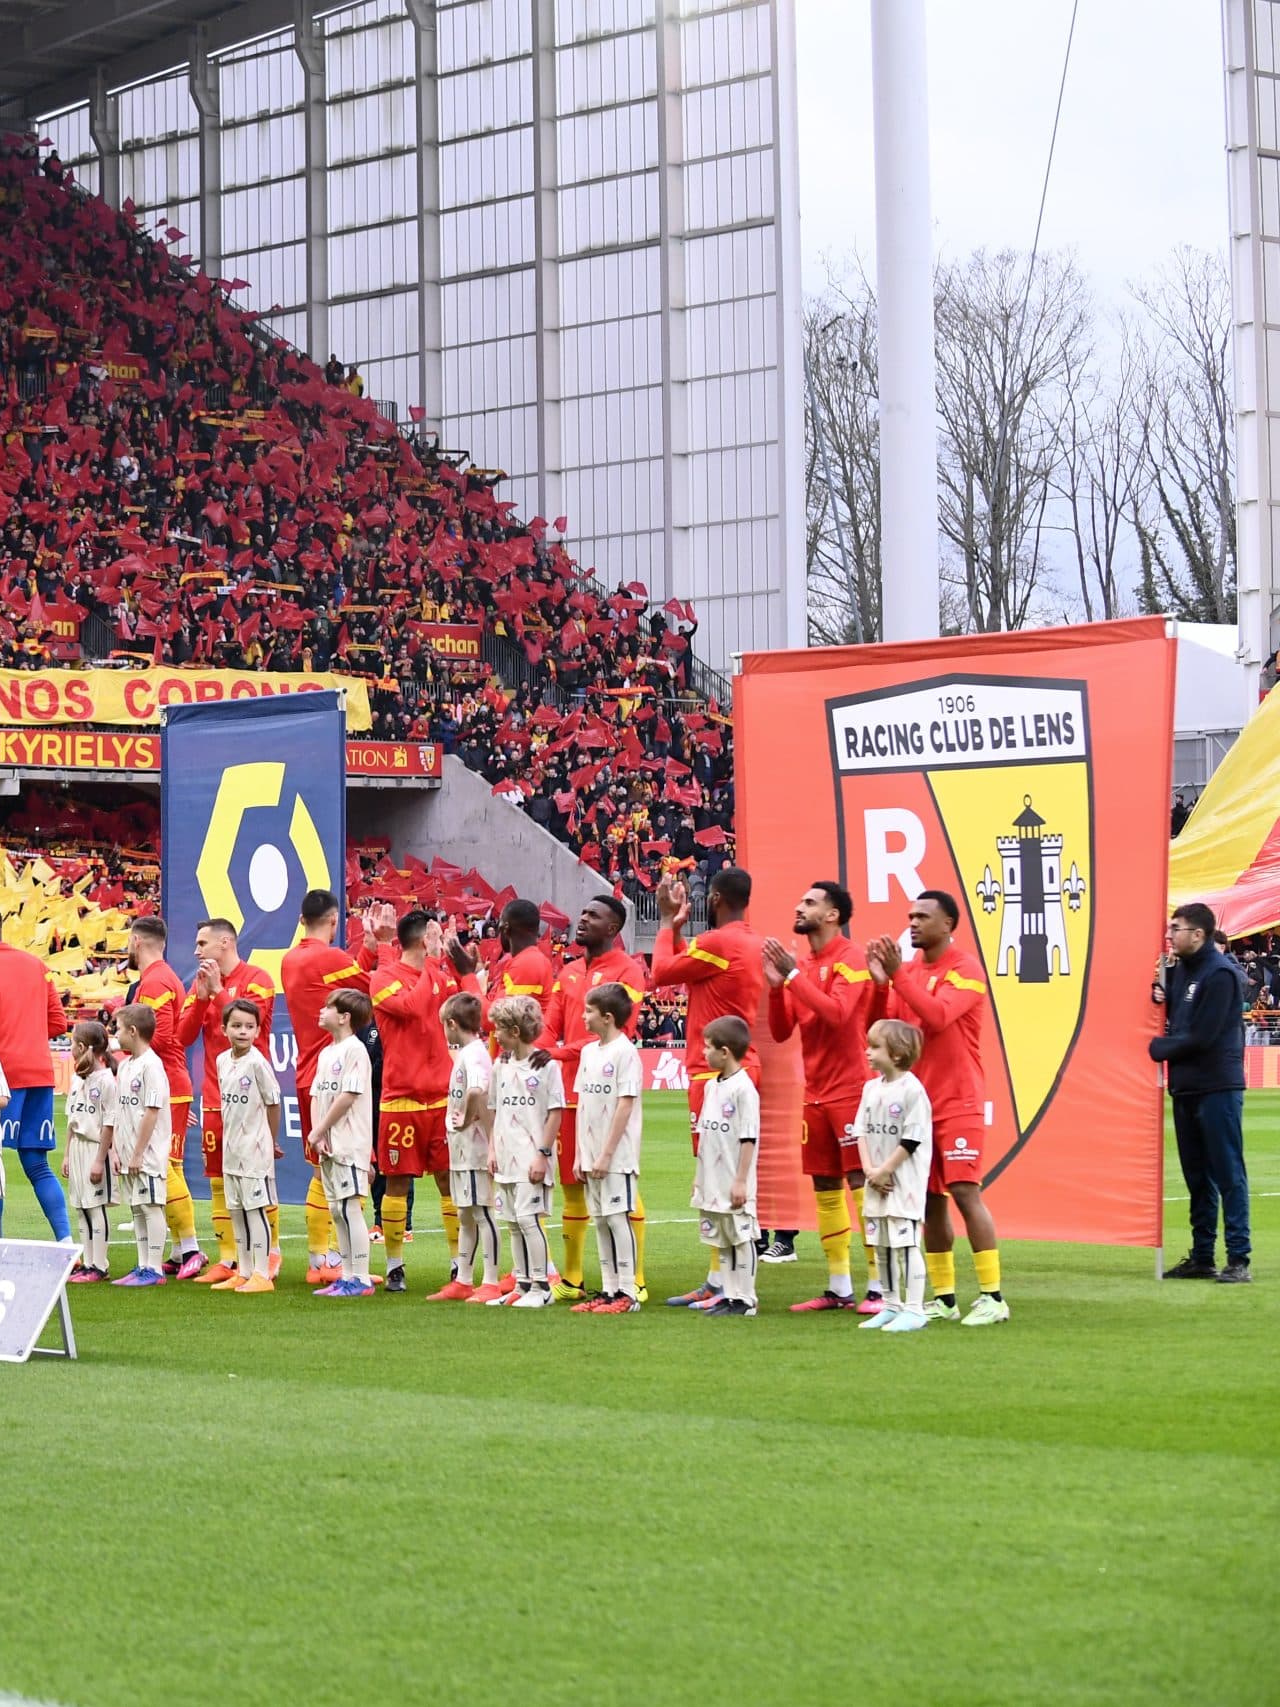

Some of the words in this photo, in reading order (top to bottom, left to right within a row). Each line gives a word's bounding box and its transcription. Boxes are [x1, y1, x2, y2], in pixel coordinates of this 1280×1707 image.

[938, 695, 976, 714] 1906
[844, 722, 924, 759] RACING
[930, 718, 982, 753] CLUB
[991, 716, 1017, 748] DE
[1022, 712, 1075, 747] LENS
[388, 1122, 415, 1148] 28
